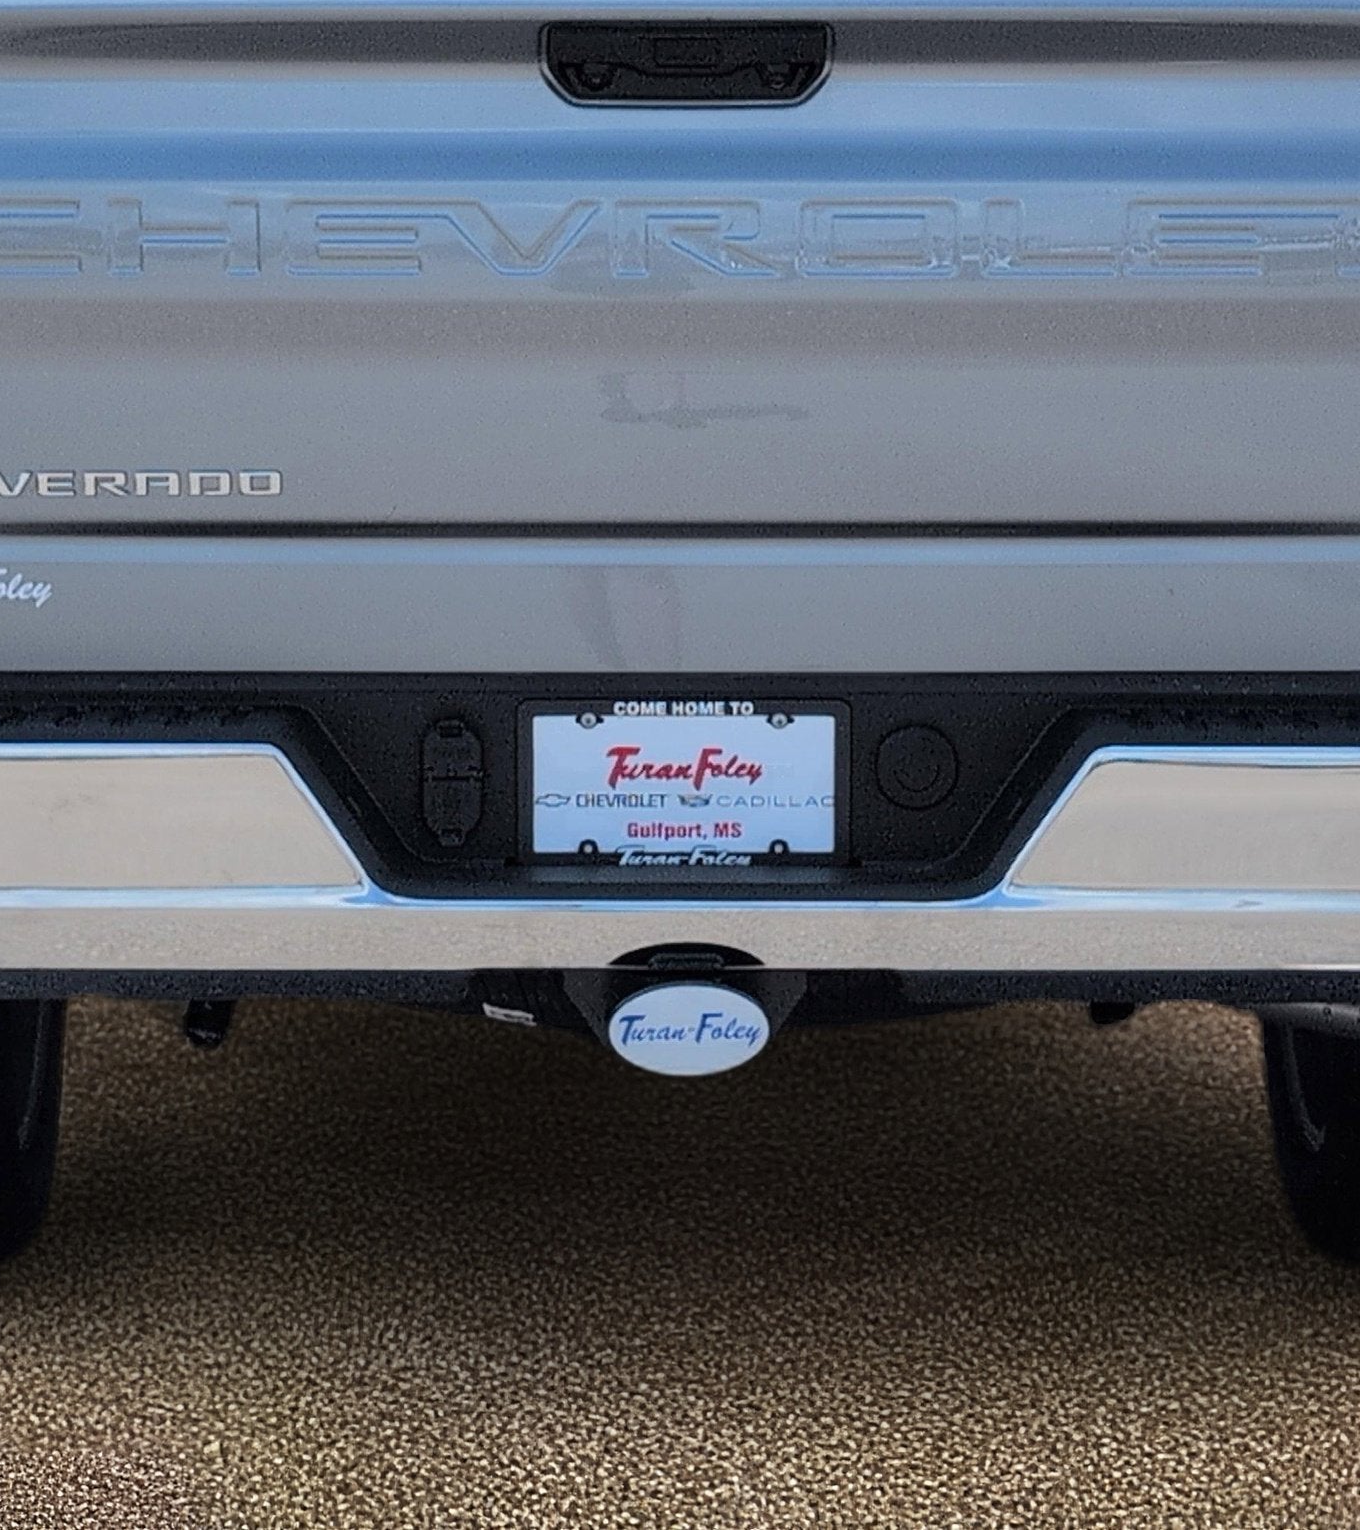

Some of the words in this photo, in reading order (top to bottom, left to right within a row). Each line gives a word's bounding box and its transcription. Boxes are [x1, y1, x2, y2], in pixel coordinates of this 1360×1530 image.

[613, 701, 666, 716] COME
[672, 701, 725, 716] HOME
[732, 701, 755, 716] TO
[575, 793, 667, 808] CHEVROLET
[717, 795, 835, 808] CADILLAC
[627, 822, 708, 841] Gulfport,
[714, 822, 742, 838] MS
